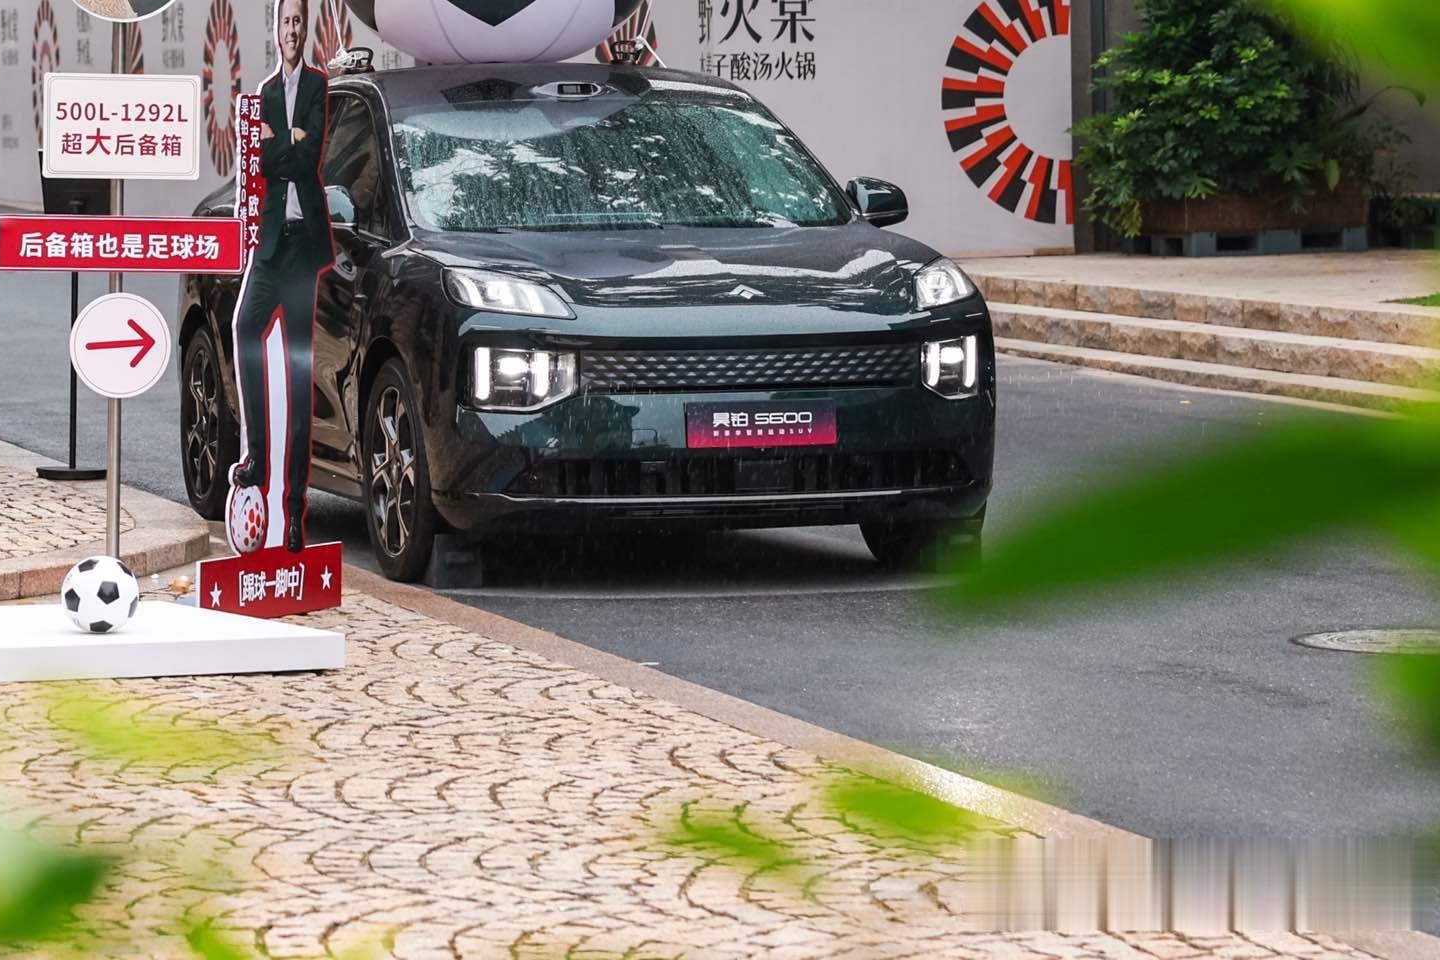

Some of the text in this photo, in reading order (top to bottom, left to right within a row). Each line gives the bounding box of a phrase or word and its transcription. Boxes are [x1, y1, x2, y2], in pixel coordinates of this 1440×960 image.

[55, 102, 189, 123] 500L-1292L
[61, 128, 182, 157] 超大后备箱
[19, 232, 220, 260] 后备箱也是足球场
[713, 411, 813, 427] 昊铂 S600
